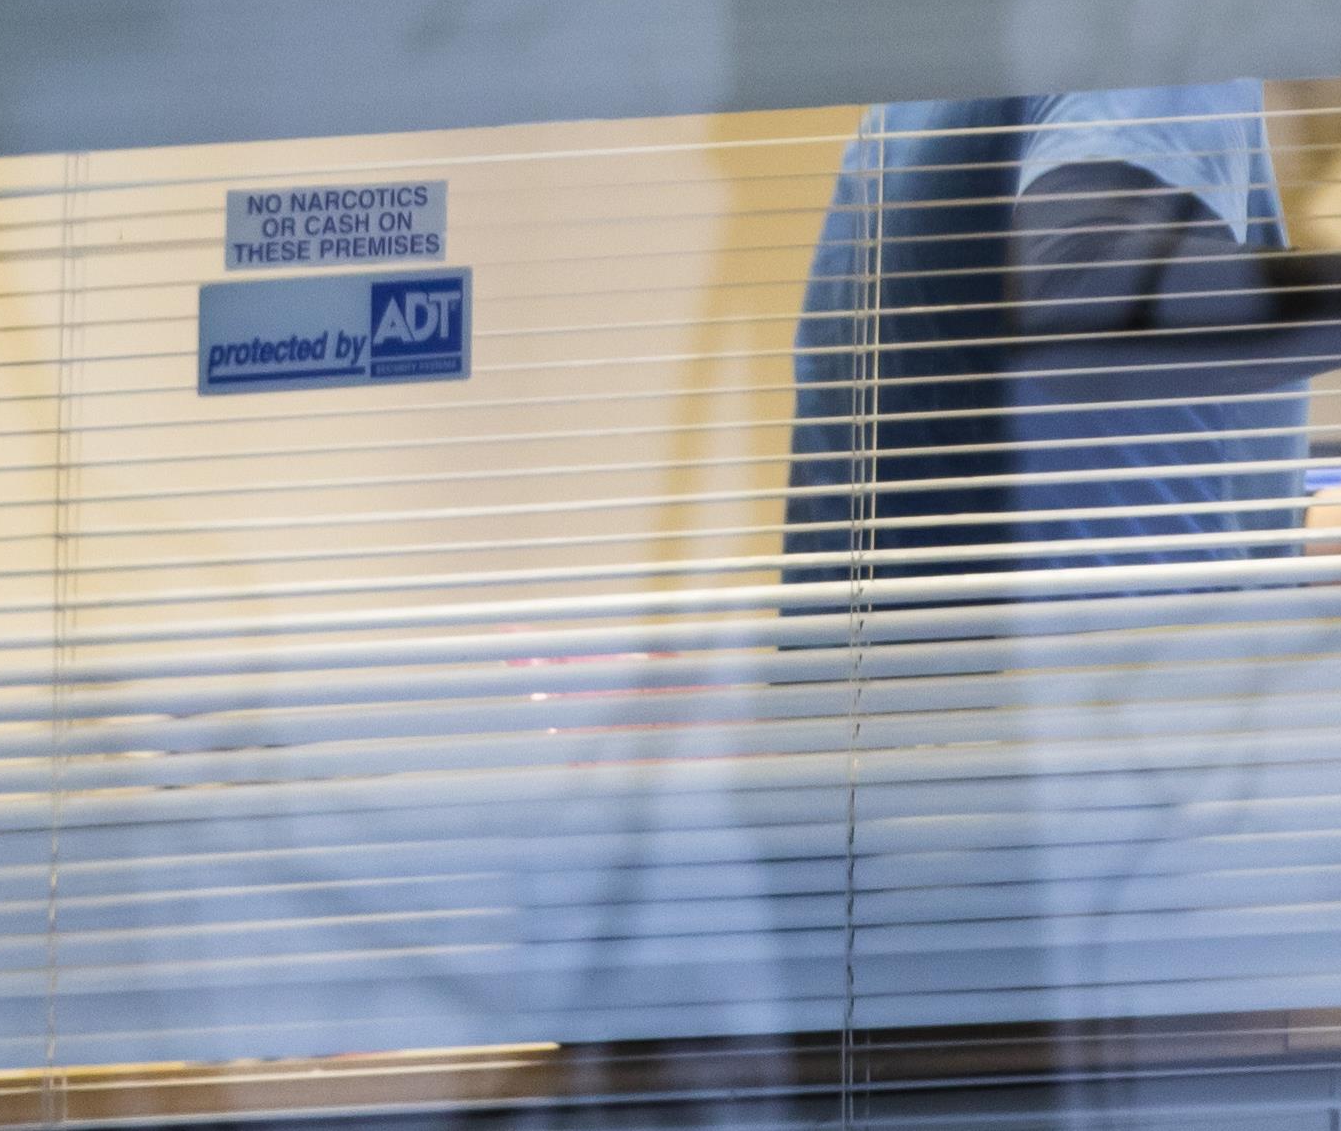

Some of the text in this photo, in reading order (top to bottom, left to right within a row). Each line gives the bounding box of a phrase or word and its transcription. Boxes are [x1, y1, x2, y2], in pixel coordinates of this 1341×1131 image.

[247, 186, 428, 215] NO NARCOTICS
[262, 211, 412, 238] OR CASH ON
[234, 233, 440, 264] THESE PREMISES
[209, 291, 461, 366] protected by ADT
